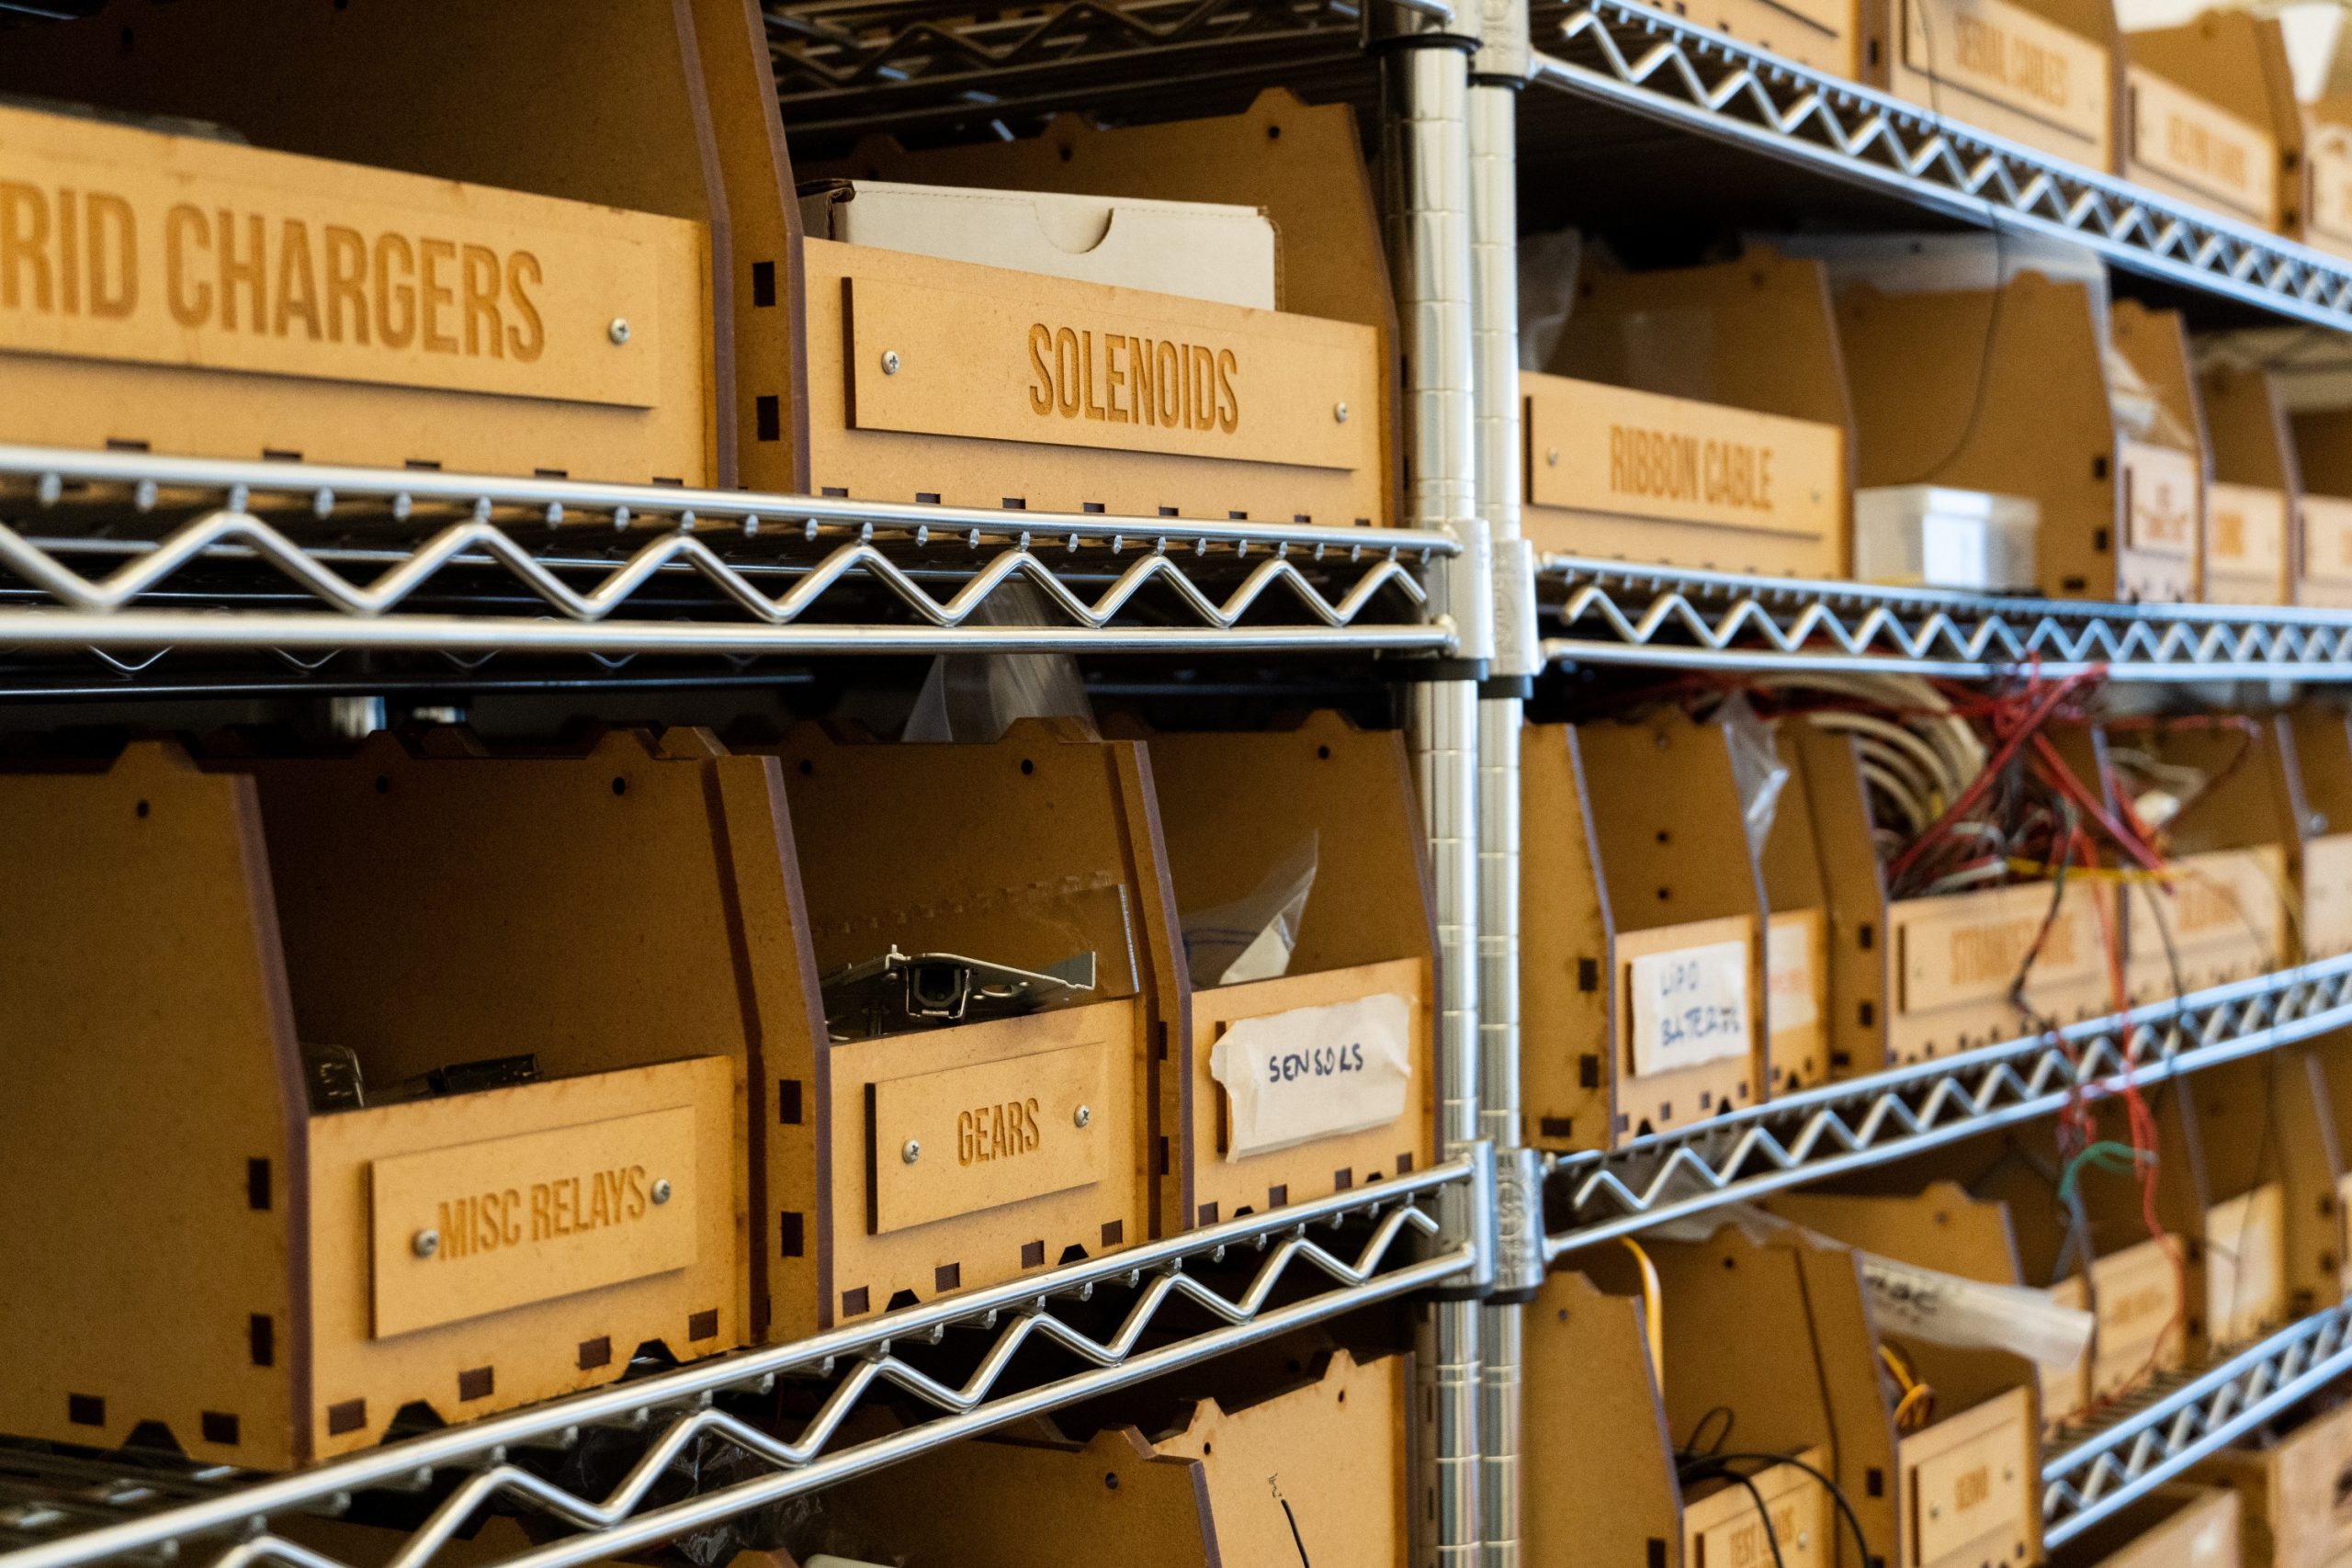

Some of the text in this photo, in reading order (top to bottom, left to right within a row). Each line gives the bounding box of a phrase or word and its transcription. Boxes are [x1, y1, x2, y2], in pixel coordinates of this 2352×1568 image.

[0, 179, 545, 363] RID CHARGERS
[1028, 322, 1239, 434] SOLENOIDS
[1611, 423, 1773, 511] RIBBON CABLE
[957, 1097, 1039, 1167] GEARS
[438, 1164, 646, 1261] MISC RELAYS
